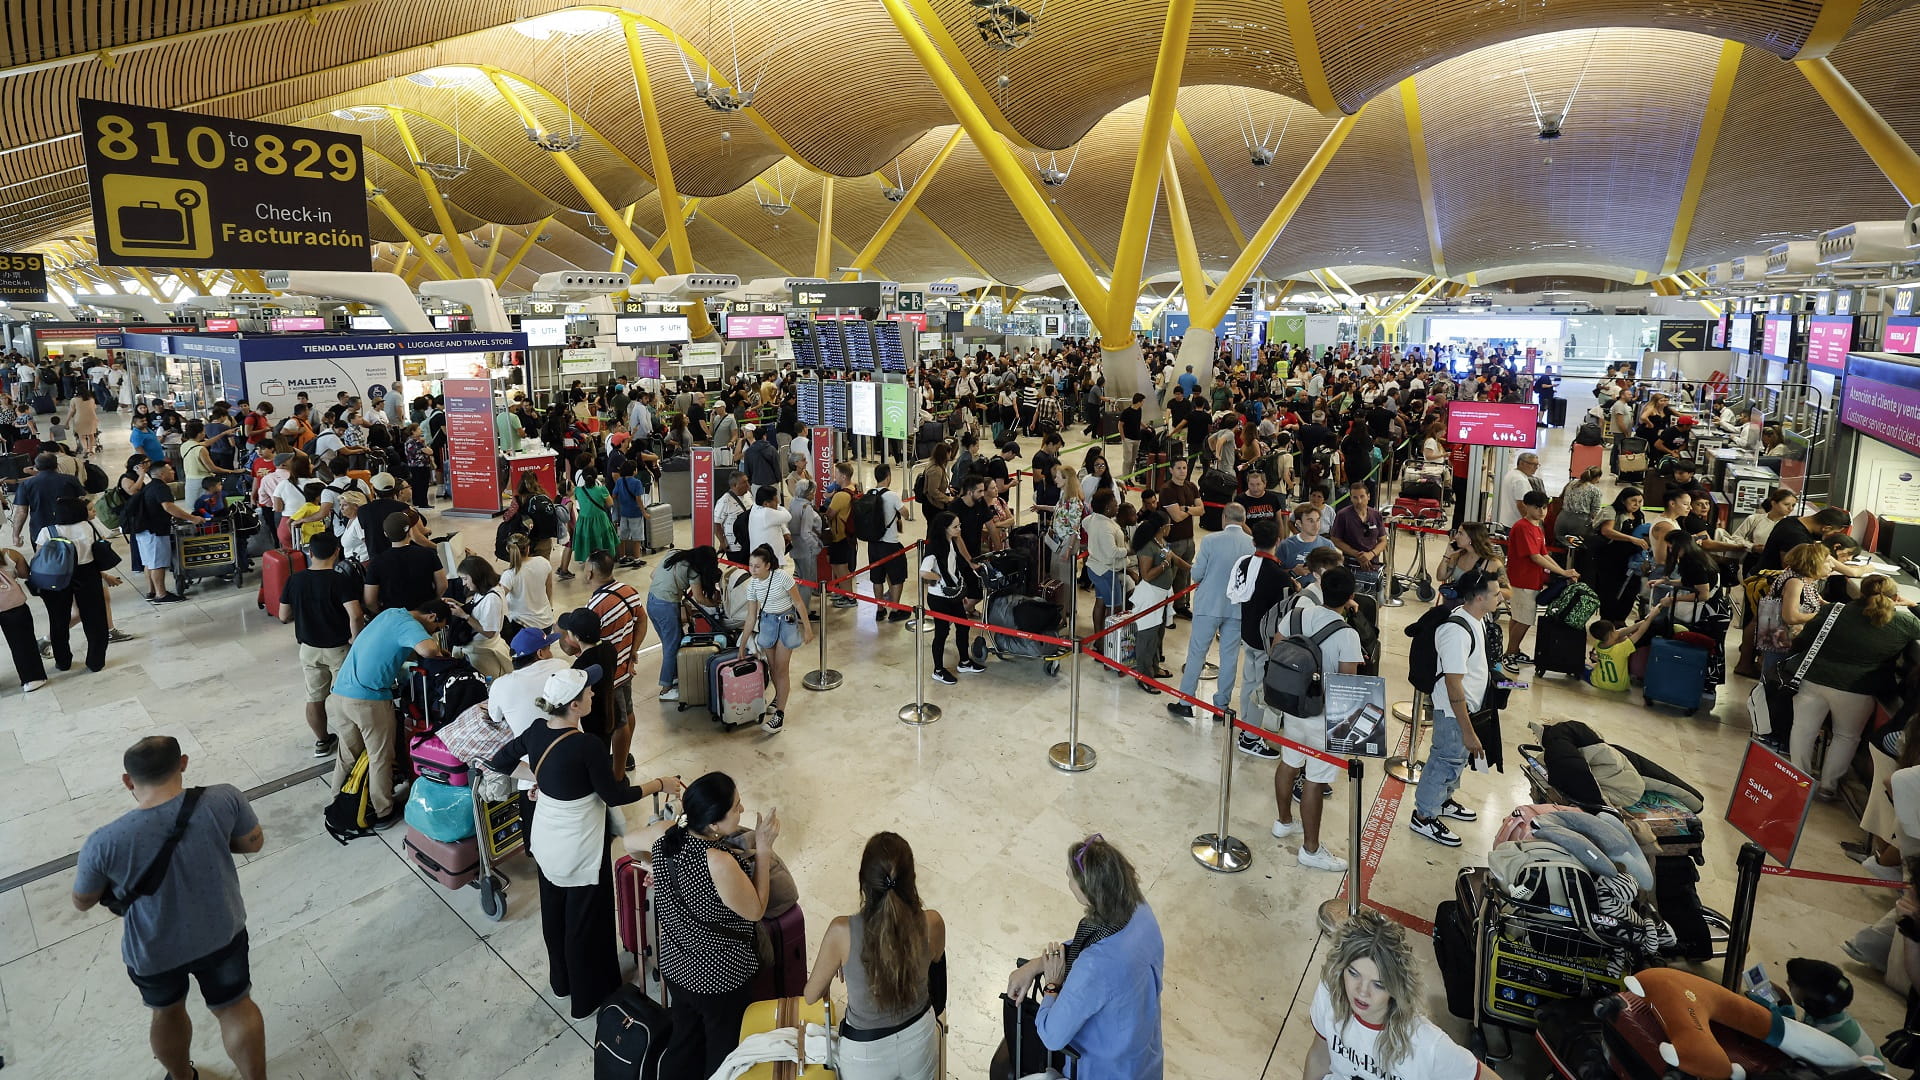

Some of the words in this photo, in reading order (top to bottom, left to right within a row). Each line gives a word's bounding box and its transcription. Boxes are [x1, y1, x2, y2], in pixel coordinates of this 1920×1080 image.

[96, 115, 226, 169] 810
[228, 132, 248, 147] to
[254, 134, 356, 182] 829
[234, 158, 248, 172] a
[256, 204, 332, 222] Check-in
[222, 223, 364, 247] Facturación
[0, 256, 40, 270] 859
[534, 304, 553, 313] 820
[1896, 291, 1912, 310] 812
[288, 377, 337, 386] MALETAS
[1849, 386, 1871, 404] Atención
[1872, 392, 1877, 406] al
[1877, 393, 1897, 412] cliente
[1896, 402, 1902, 418] y
[1847, 407, 1868, 426] Customer
[1868, 418, 1886, 434] service
[1886, 424, 1899, 438] and
[1898, 426, 1916, 445] ticket
[819, 446, 830, 473] sales
[1600, 660, 1618, 683] 10
[1775, 762, 1799, 780] IBERIA
[1745, 789, 1759, 804] Exit
[1748, 778, 1772, 800] Salida
[1372, 798, 1387, 819] ESPERE
[1388, 799, 1400, 812] WAIT
[1384, 811, 1395, 821] FOR
[1364, 830, 1375, 840] SU
[1377, 822, 1391, 836] YOUR
[1372, 836, 1386, 852] TURN
[1366, 851, 1380, 869] HERE
